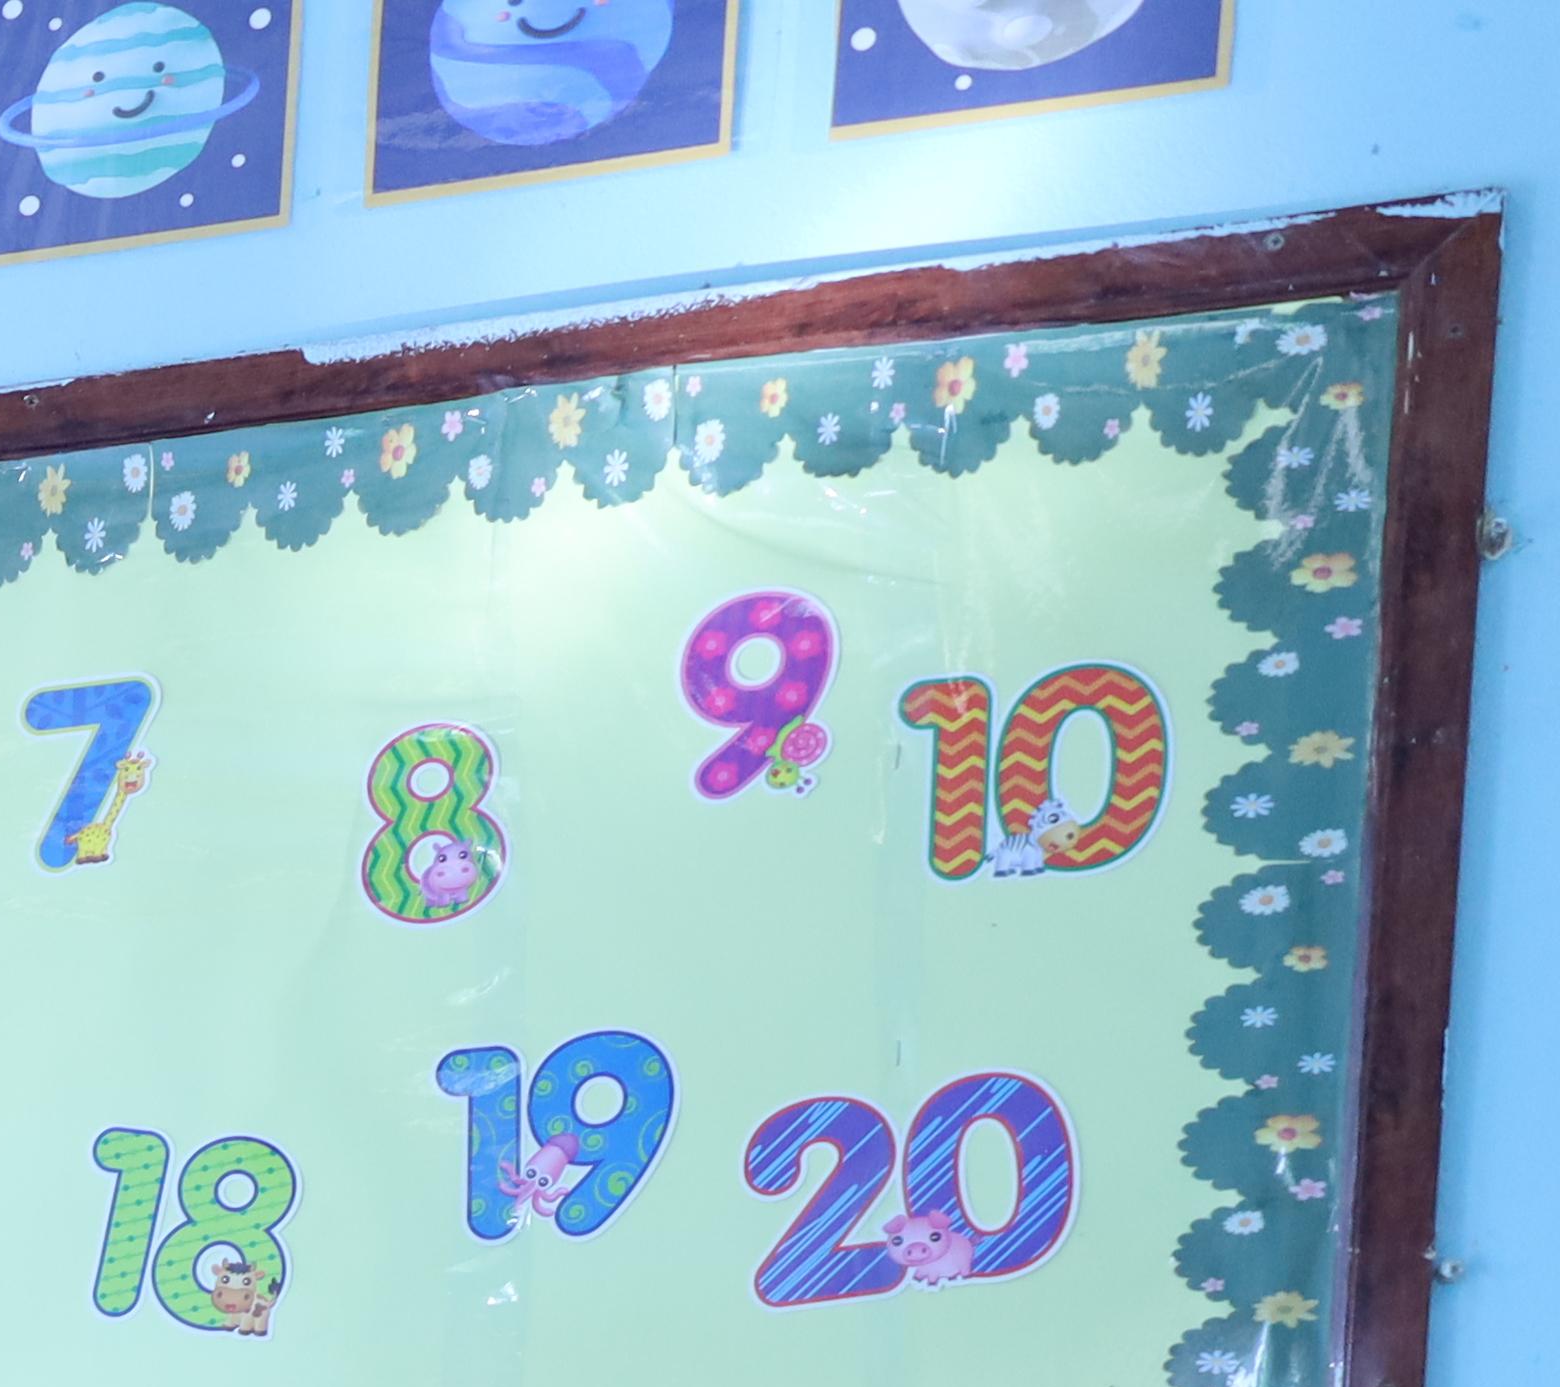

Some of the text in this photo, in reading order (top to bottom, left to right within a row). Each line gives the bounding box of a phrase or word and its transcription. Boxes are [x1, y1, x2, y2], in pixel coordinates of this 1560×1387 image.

[23, 679, 155, 870] 7
[679, 589, 835, 800] 9
[897, 662, 1168, 881] 10
[361, 722, 504, 923] 8
[92, 1127, 297, 1332] 18
[435, 1029, 675, 1240] 19
[744, 1072, 1073, 1308] 20
